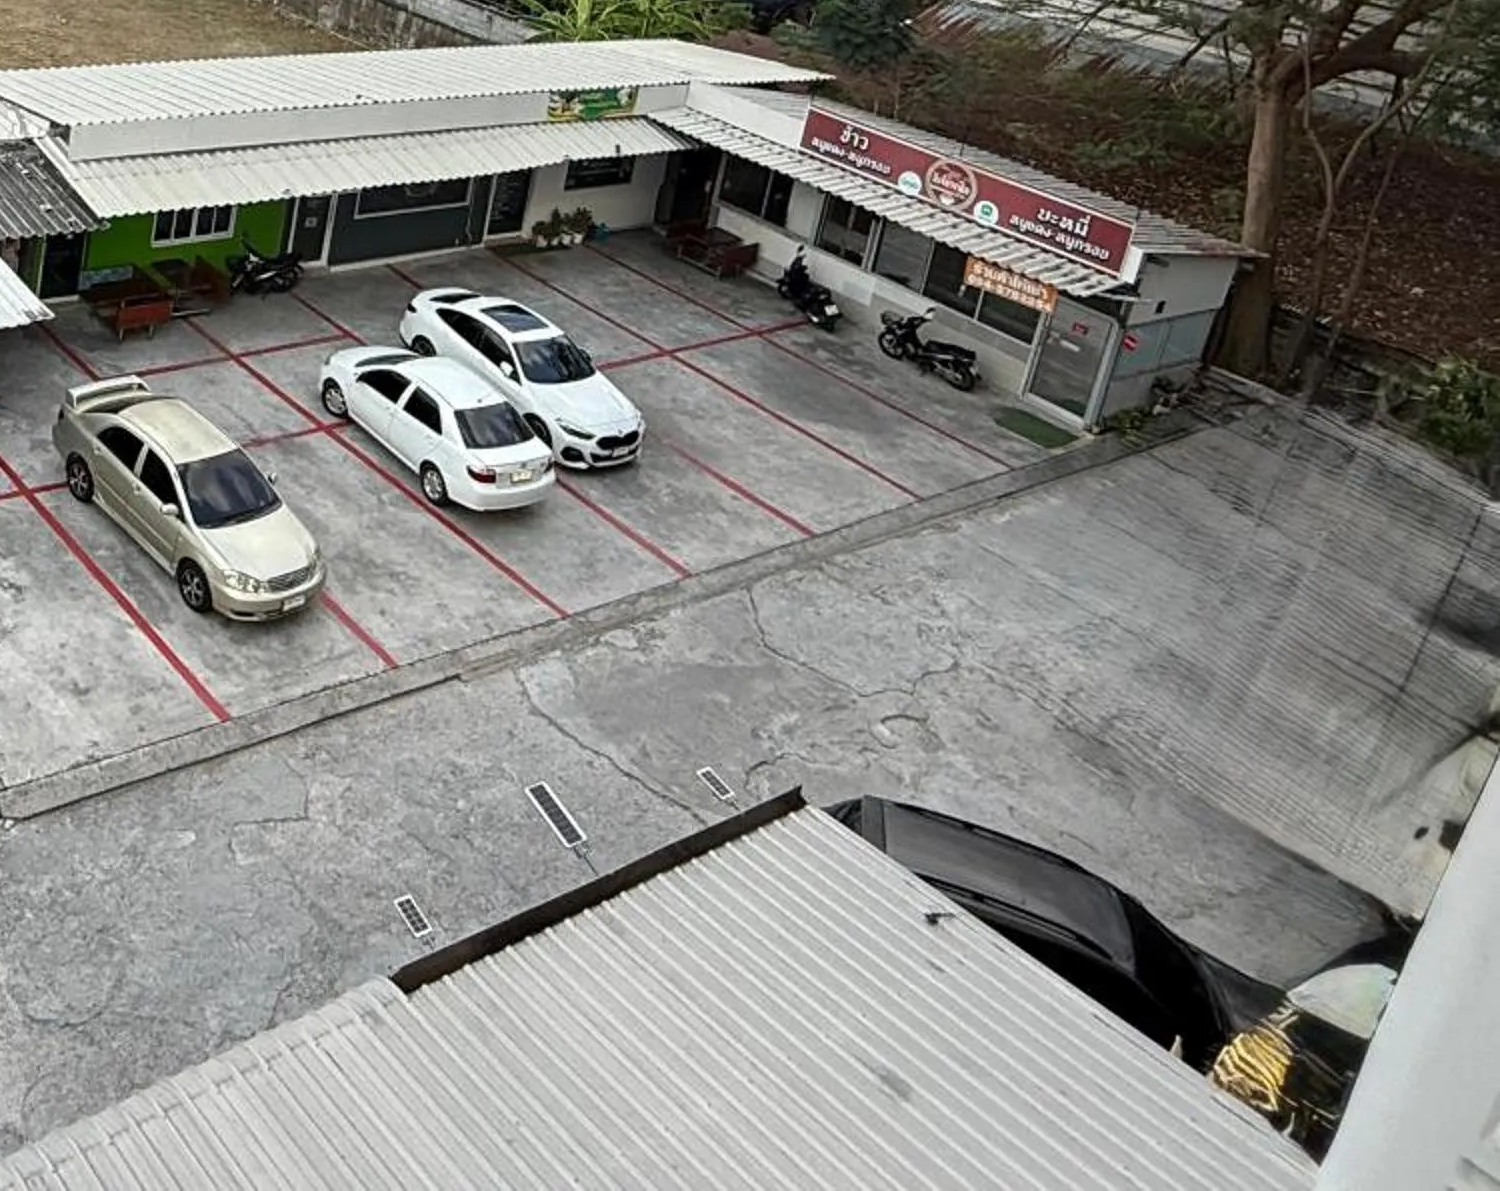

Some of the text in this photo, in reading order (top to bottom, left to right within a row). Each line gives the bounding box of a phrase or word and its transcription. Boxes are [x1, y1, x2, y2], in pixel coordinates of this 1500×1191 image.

[840, 125, 869, 150] ข้าว
[1037, 208, 1091, 237] บะหมี่
